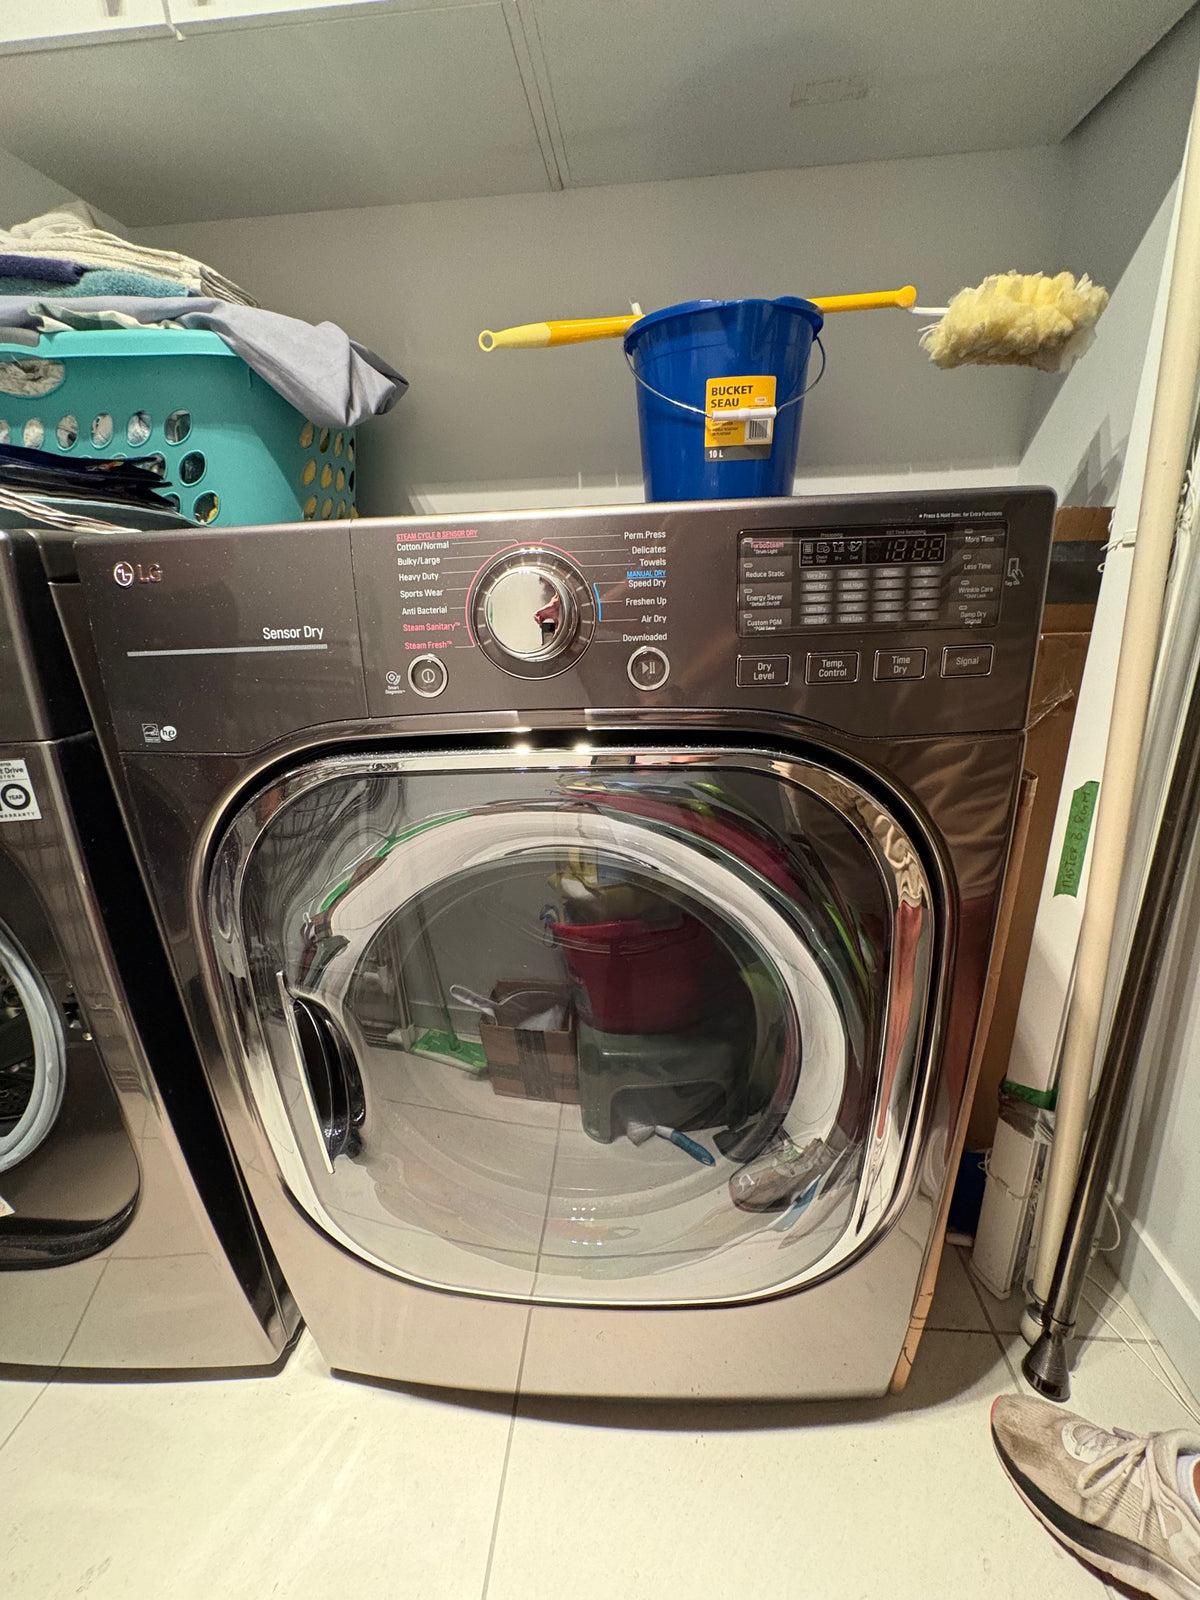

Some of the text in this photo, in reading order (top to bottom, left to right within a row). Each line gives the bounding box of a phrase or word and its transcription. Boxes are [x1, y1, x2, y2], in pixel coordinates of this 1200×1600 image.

[711, 385, 754, 396] BUCKET
[711, 398, 739, 408] SEAU
[709, 449, 724, 458] 10 L
[465, 529, 478, 537] DRY
[965, 535, 980, 543] More
[396, 541, 450, 551] Cotton/Normal
[631, 546, 667, 554] Delicates
[397, 557, 441, 566] Bulky/Large
[639, 558, 667, 566] Towels
[137, 562, 163, 583] LG
[398, 572, 439, 582] Heavy Duty
[626, 569, 667, 578] MANUAL DRY
[628, 579, 667, 589] Speed Dry
[400, 591, 424, 600] Sports
[625, 597, 667, 606] Freshen Up
[401, 606, 448, 616] Anti Bacterial
[653, 615, 667, 623] Dry
[262, 625, 324, 640] Sensor Dry
[403, 624, 425, 632] Steam
[622, 633, 668, 642] Downloaded
[405, 642, 427, 650] Steam
[822, 660, 844, 669] Temp.
[892, 656, 911, 664] Time
[956, 657, 980, 667] Signal
[757, 662, 772, 672] Dry
[893, 665, 908, 674] Dry
[753, 672, 775, 680] Level
[818, 669, 847, 677] Control
